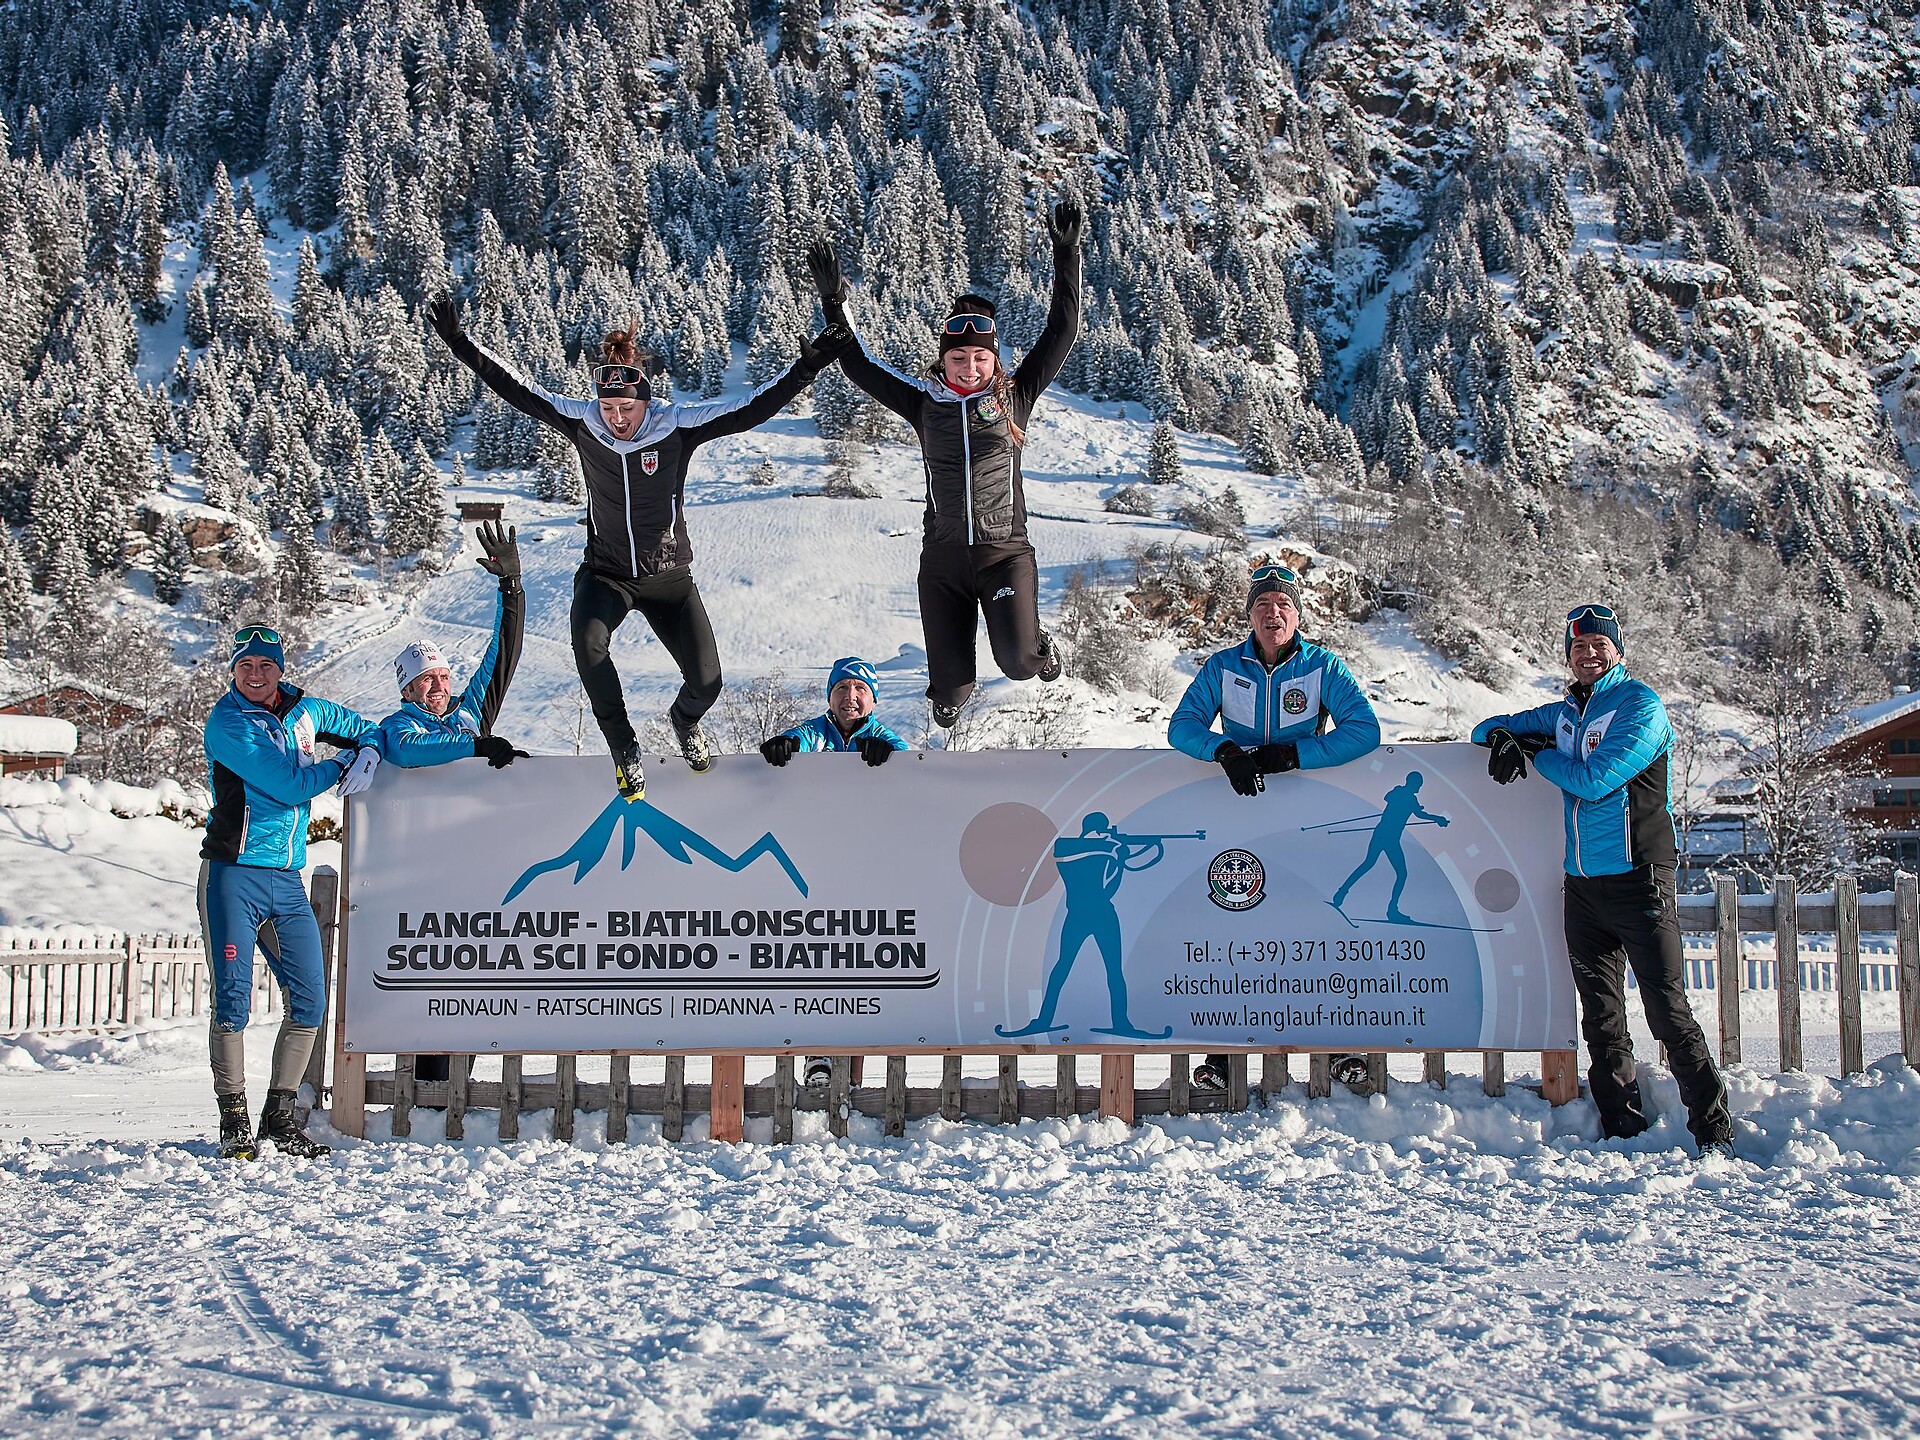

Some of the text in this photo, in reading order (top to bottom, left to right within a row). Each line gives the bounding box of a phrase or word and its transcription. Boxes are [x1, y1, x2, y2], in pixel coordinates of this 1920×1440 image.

[398, 911, 579, 939] LANGLAUF
[607, 910, 917, 938] BIATHLONSCHULE
[386, 943, 525, 971] SCUOLA
[533, 943, 586, 971] SCI
[596, 943, 718, 970] FONDO
[749, 942, 926, 970] BIATHLON
[1183, 939, 1426, 967] Tel.: (+39) 371 3501430
[1164, 971, 1449, 1000] skischuleridnaun@gmail.com
[429, 998, 518, 1016] RIDNAUN
[537, 997, 663, 1016] RATSCHINGS
[683, 997, 776, 1016] RIDANNA
[794, 997, 881, 1015] RACINES
[1190, 1003, 1427, 1033] www.langlauf-ridnaun.it
